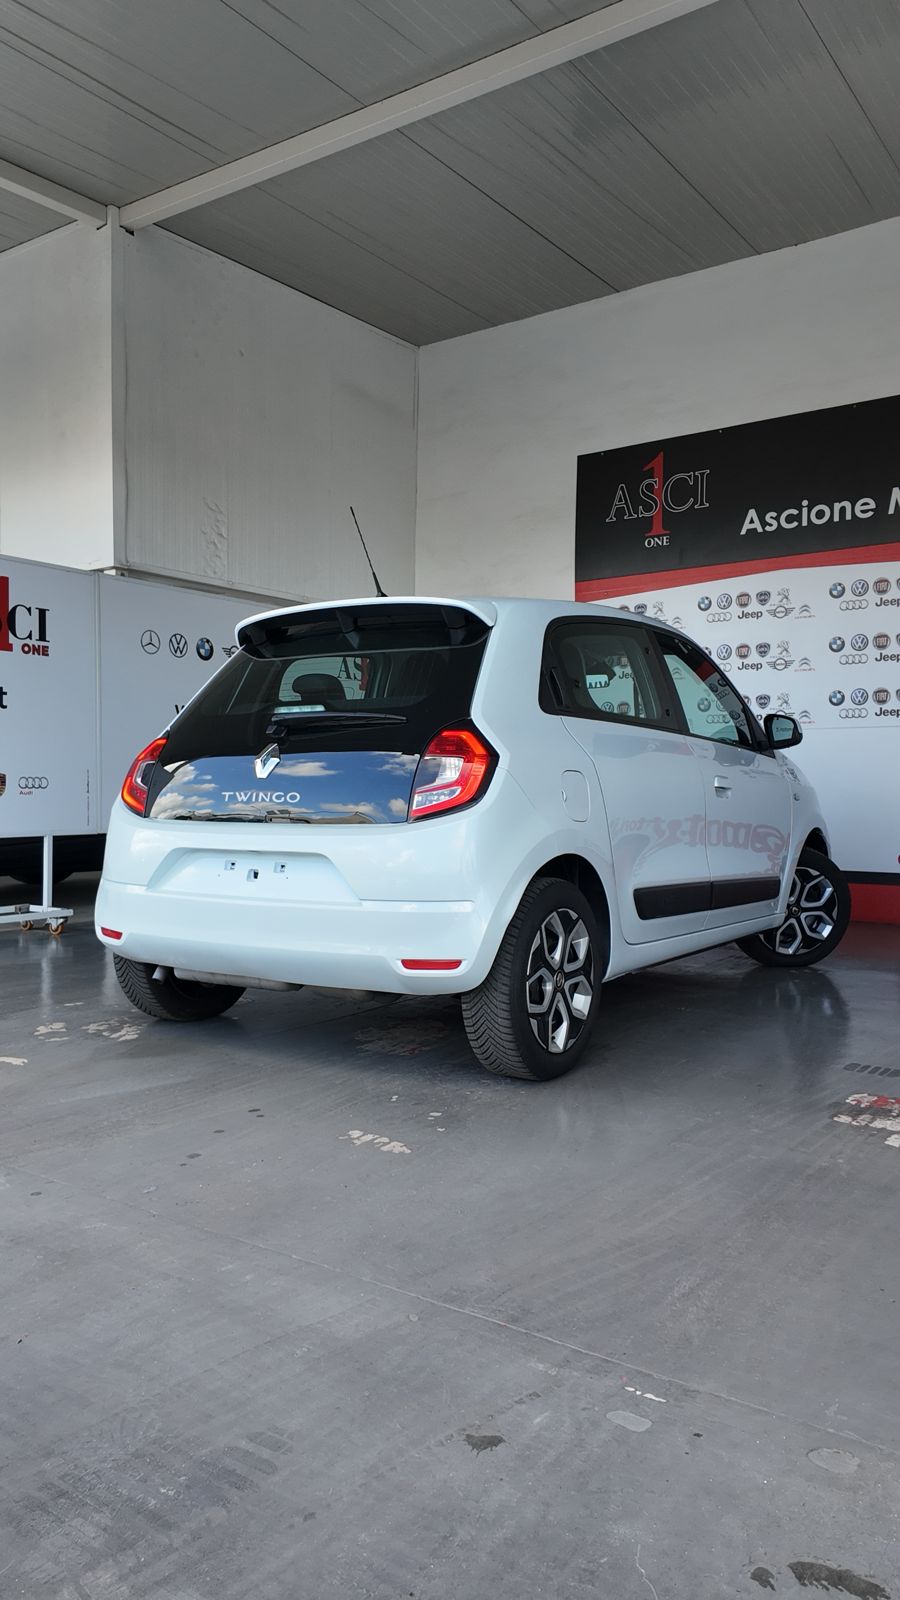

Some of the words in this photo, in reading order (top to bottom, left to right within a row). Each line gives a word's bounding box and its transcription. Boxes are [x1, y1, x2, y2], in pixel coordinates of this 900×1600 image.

[606, 469, 710, 522] ASCI
[740, 497, 876, 535] Ascione
[644, 536, 670, 549] ONE
[738, 610, 763, 620] Jeep
[21, 643, 50, 657] ONE
[738, 661, 763, 672] Jeep
[221, 791, 301, 804] TWINGO
